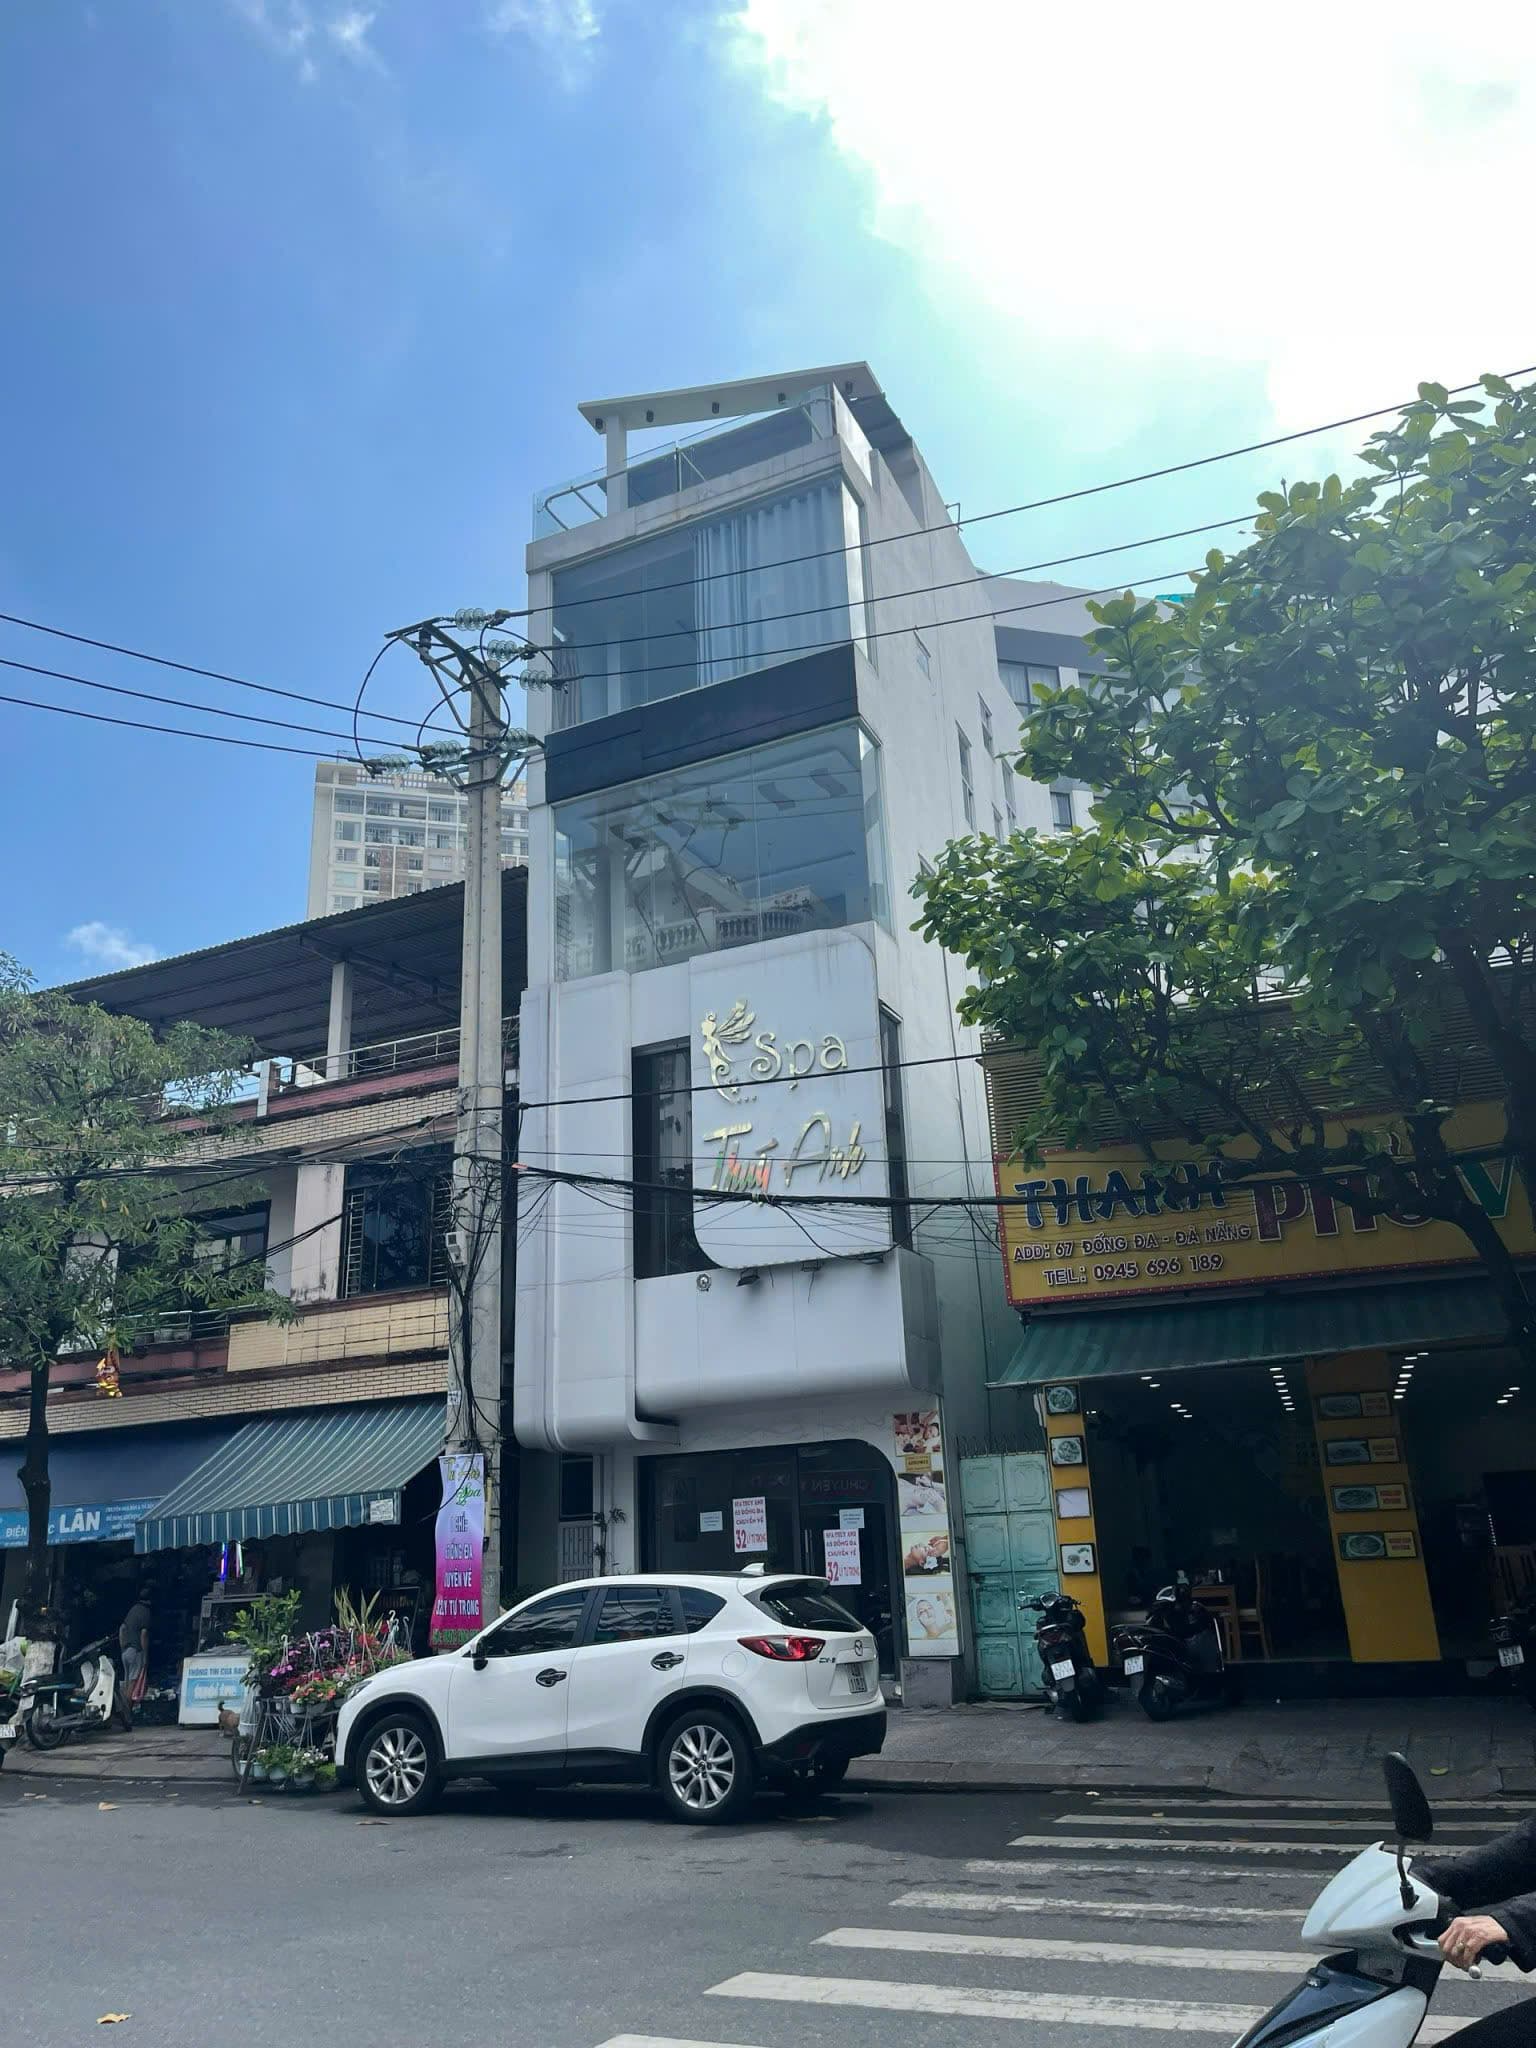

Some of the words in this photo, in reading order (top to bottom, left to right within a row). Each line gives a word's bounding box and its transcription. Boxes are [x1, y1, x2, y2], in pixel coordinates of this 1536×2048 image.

[750, 1032, 848, 1091] Spa
[784, 1111, 866, 1188] Anh
[1014, 1244, 1050, 1262] ADD:
[1055, 1241, 1074, 1258] 67
[1082, 1231, 1128, 1255] ĐỐNG
[1134, 1233, 1159, 1250] ĐA
[1175, 1226, 1200, 1245] ĐÀ
[1044, 1267, 1087, 1286] TEL:
[1093, 1262, 1139, 1280] 0945
[1146, 1257, 1182, 1276] 696
[1189, 1253, 1224, 1273] 189
[60, 1508, 100, 1534] LÂN
[736, 1529, 747, 1549] 32
[828, 1561, 840, 1581] 32
